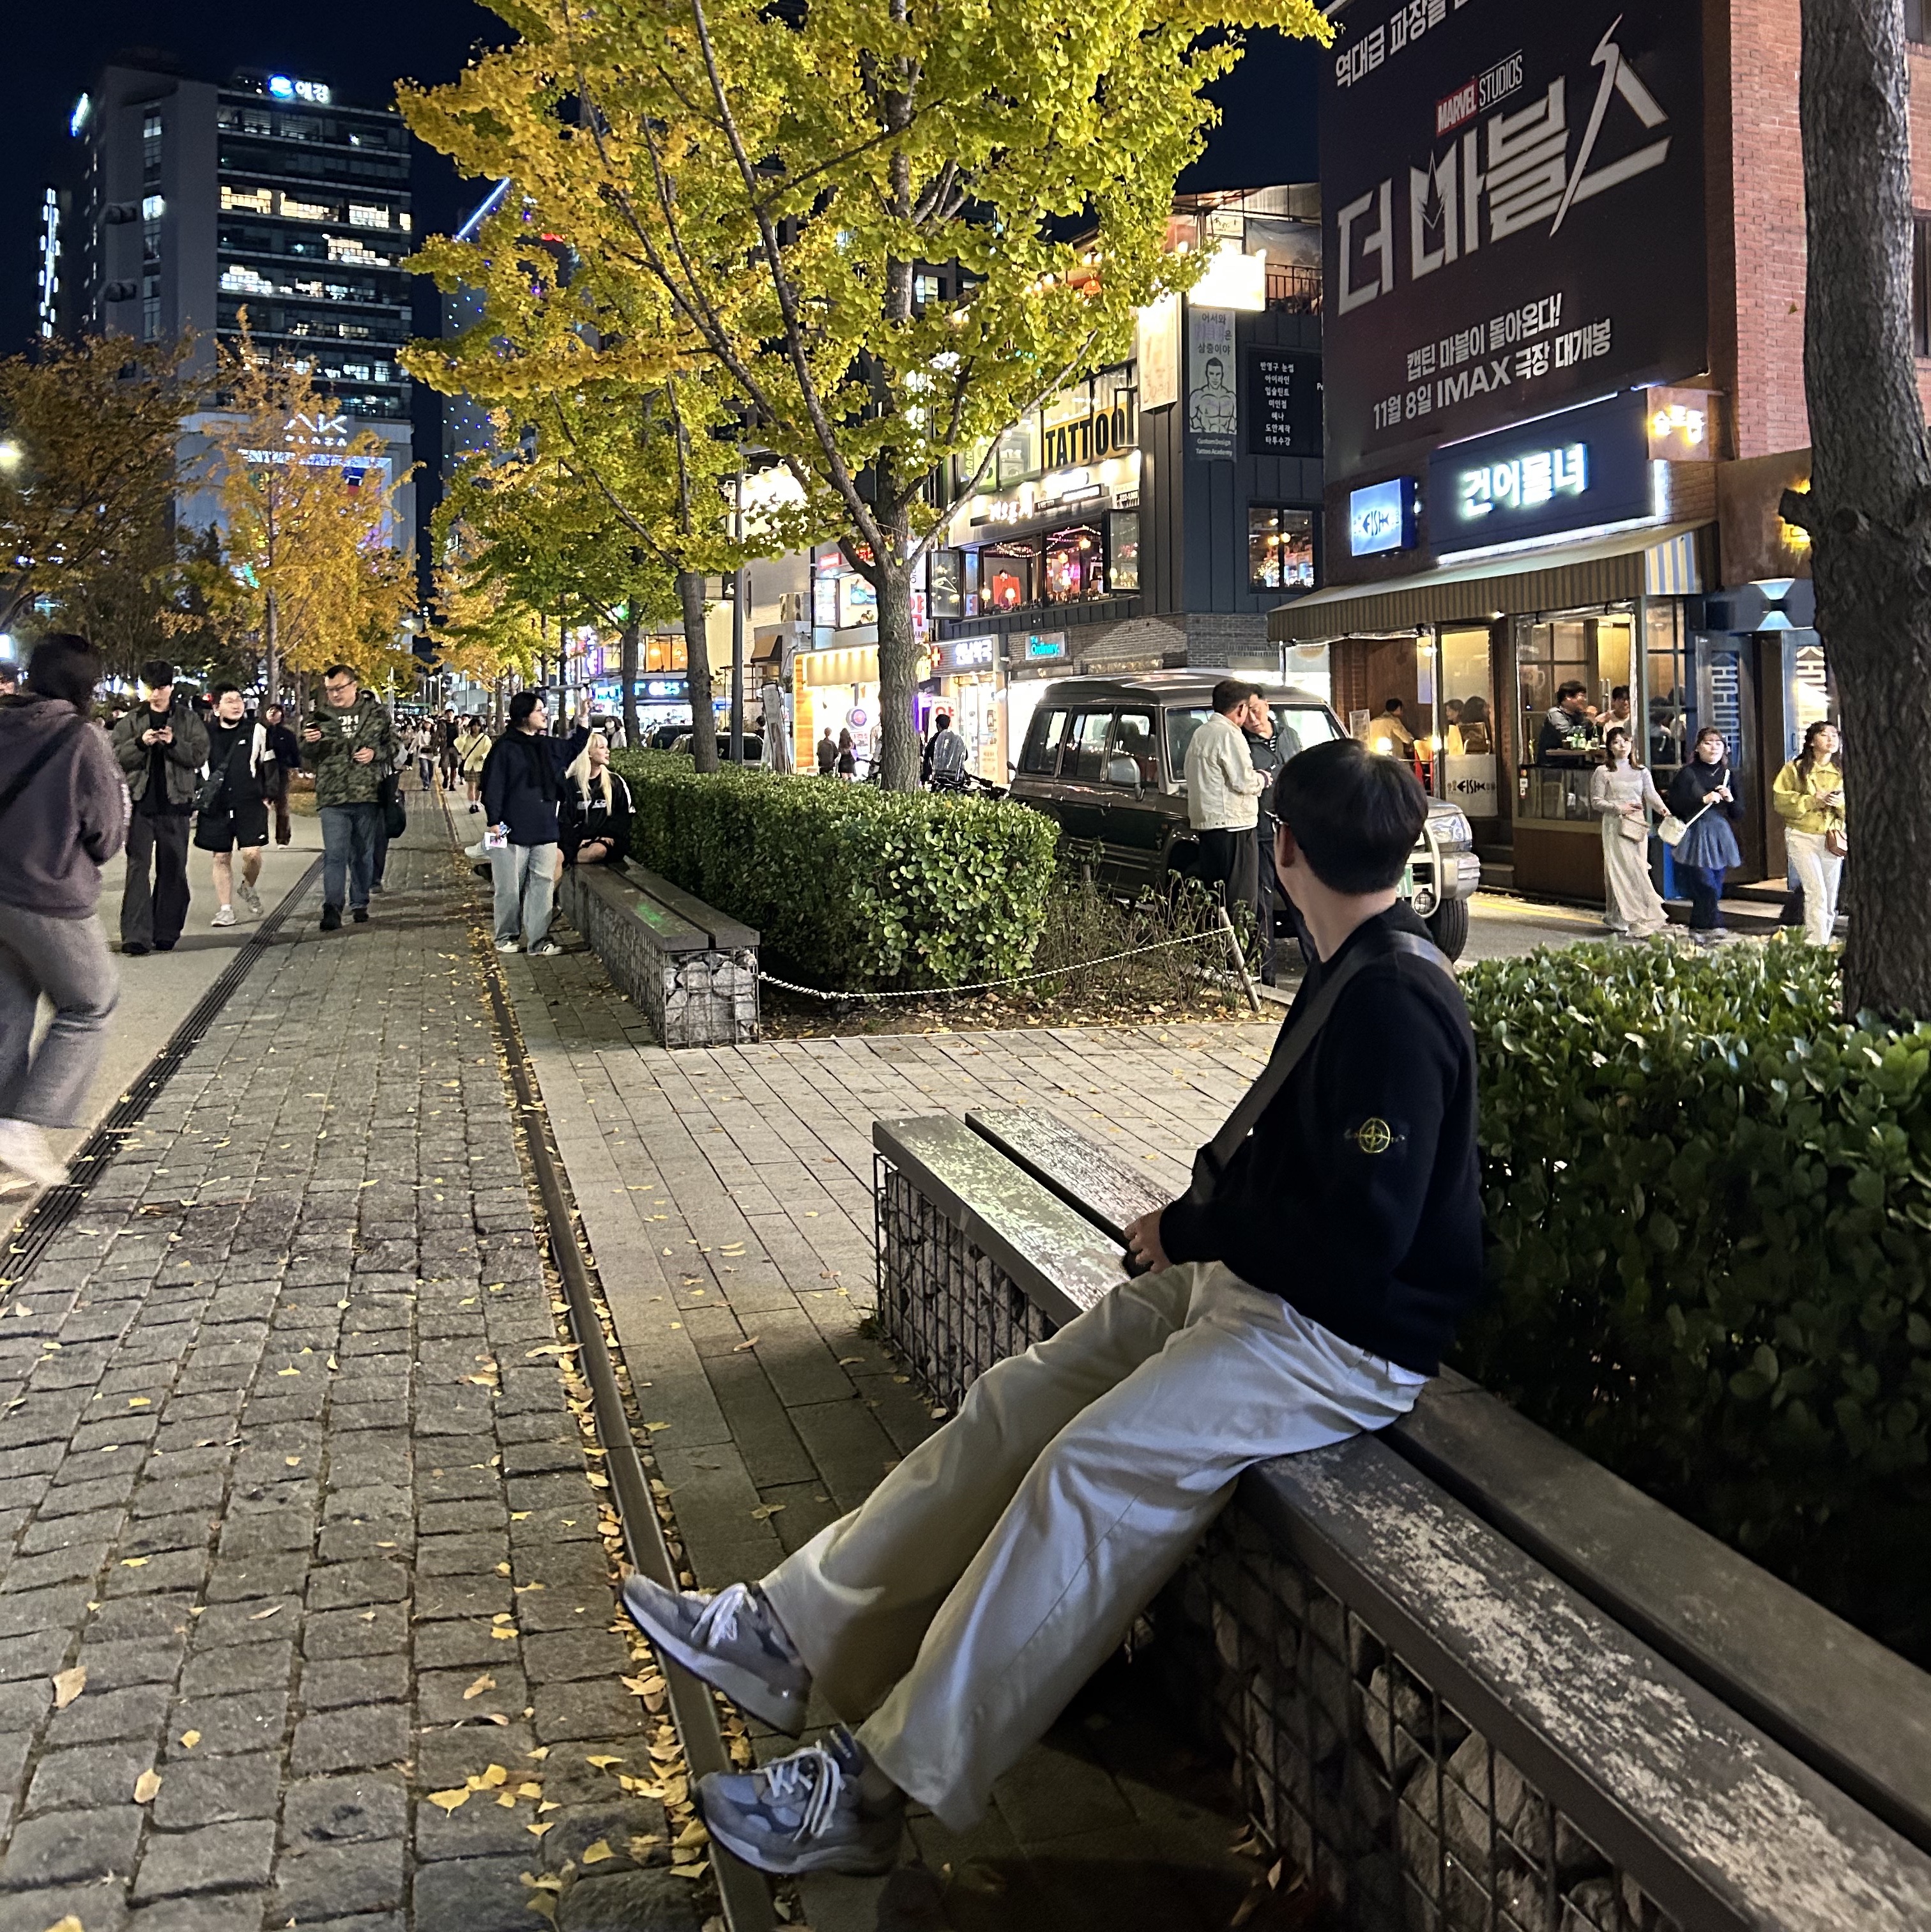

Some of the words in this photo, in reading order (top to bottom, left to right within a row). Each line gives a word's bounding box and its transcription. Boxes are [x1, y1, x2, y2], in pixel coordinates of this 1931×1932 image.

[1336, 25, 1384, 87] 역대급
[1437, 88, 1477, 133] MARVEL
[1479, 56, 1522, 107] STUDIOS
[1338, 178, 1394, 316] 더
[1410, 13, 1672, 281] 마블스
[1202, 312, 1226, 325] 어서와
[1407, 348, 1435, 381] 캡틴
[1440, 324, 1485, 369] 마블이
[1490, 293, 1562, 352] 돌아온다!
[1198, 342, 1230, 355] 삼층이야
[1260, 362, 1279, 371] 반영구
[1264, 374, 1290, 385] 아이라인
[1373, 394, 1401, 430] 11월
[1405, 386, 1431, 420] 8일
[1437, 356, 1511, 409] IMAX
[1515, 341, 1550, 379] 극장
[1555, 318, 1611, 369] 대개봉
[1268, 399, 1287, 409] 미인점
[1046, 408, 1125, 469] TATTOO
[1265, 424, 1291, 433] 도안제작
[1265, 436, 1291, 446] 타투수강
[1462, 441, 1587, 518] 건어물녀
